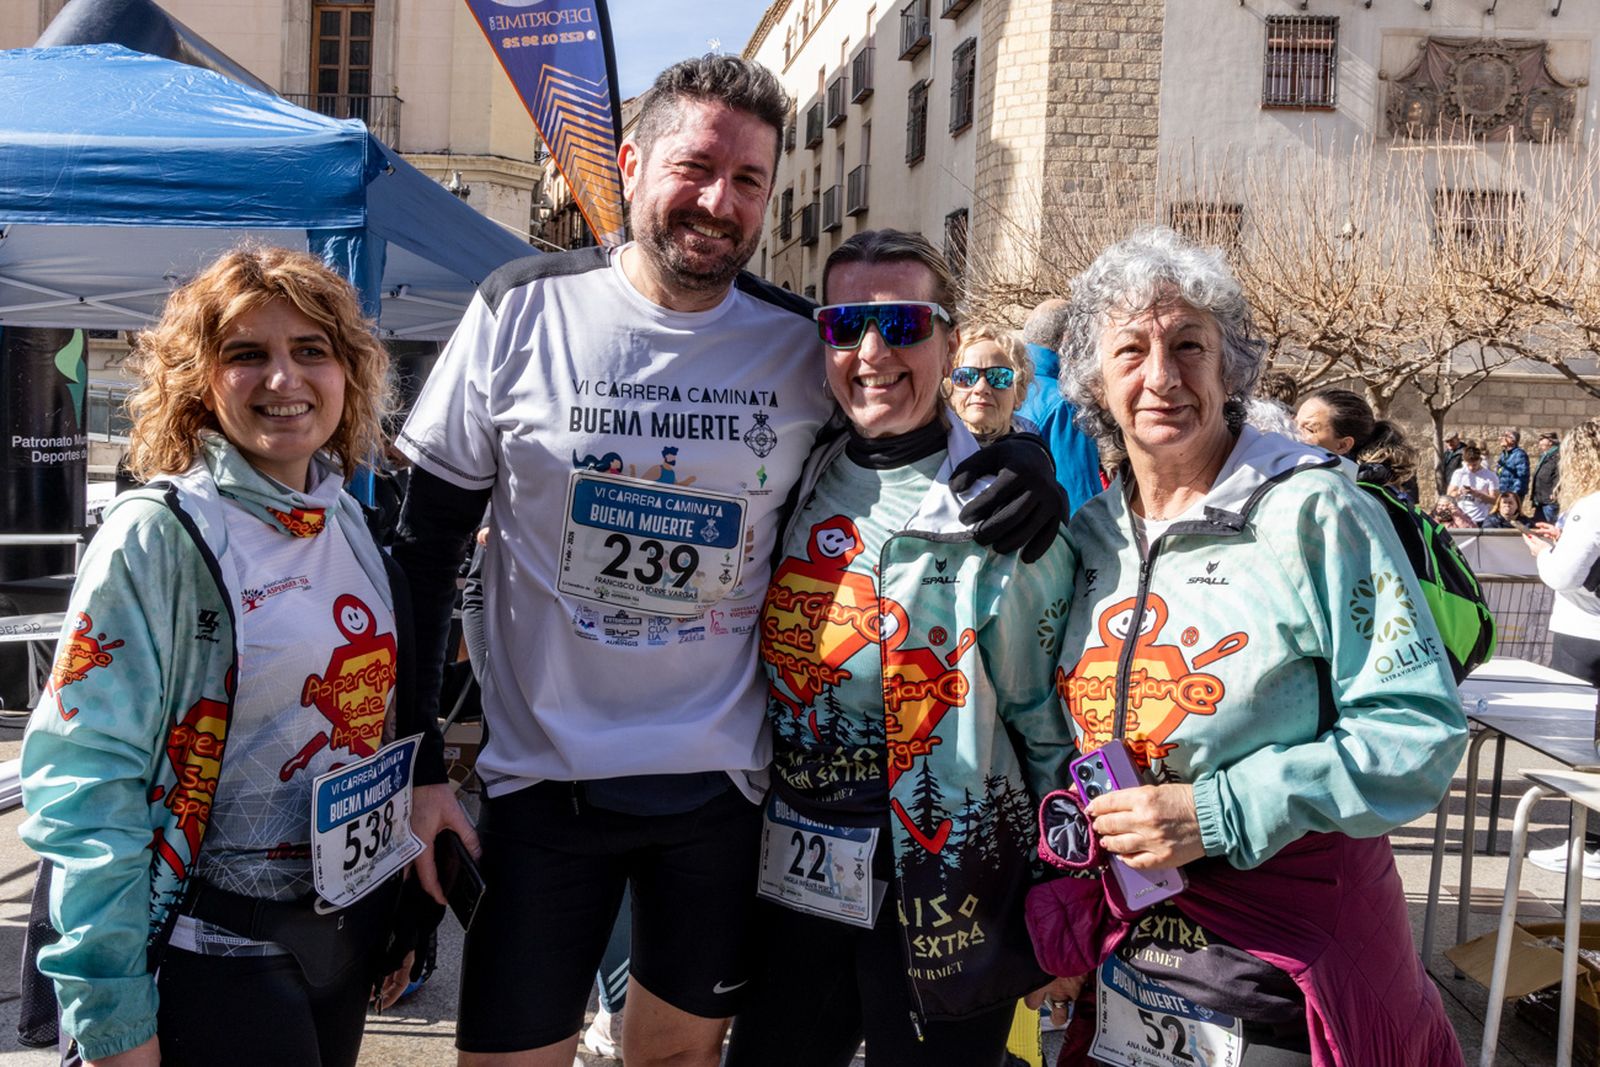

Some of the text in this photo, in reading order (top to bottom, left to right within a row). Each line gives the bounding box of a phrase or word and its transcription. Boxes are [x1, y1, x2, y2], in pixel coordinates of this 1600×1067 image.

[572, 379, 779, 408] VI CARRERA CAMINATA
[569, 406, 741, 441] BUENA MUERTE
[12, 435, 72, 448] Patronato
[32, 450, 80, 465] Deportes
[594, 486, 724, 517] VI CARRERA CAMINATA
[590, 504, 695, 538] BUENA MUERTE
[600, 533, 700, 589] 239
[594, 575, 635, 591] FRANCISCO
[668, 589, 698, 600] VARGAS
[921, 576, 961, 586] SPALL
[1186, 577, 1230, 586] SPALL
[331, 718, 385, 753] Asper
[886, 737, 942, 770] ger
[331, 749, 405, 796] VI CARRERA CAMINATA
[815, 761, 881, 788] EXTRA
[329, 774, 393, 823] BUENA MUERTE
[343, 799, 394, 871] 538
[787, 830, 826, 883] 22
[912, 921, 986, 959] EXTRA
[1136, 913, 1210, 952] EXTRA
[907, 960, 964, 981] OURMET
[1122, 946, 1183, 969] OURMET
[1112, 965, 1138, 1001] BUENA
[1138, 986, 1190, 1014] MUERTE
[1126, 1040, 1141, 1051] ANA
[1141, 1044, 1163, 1058] MARIA
[1137, 1008, 1195, 1063] 52
